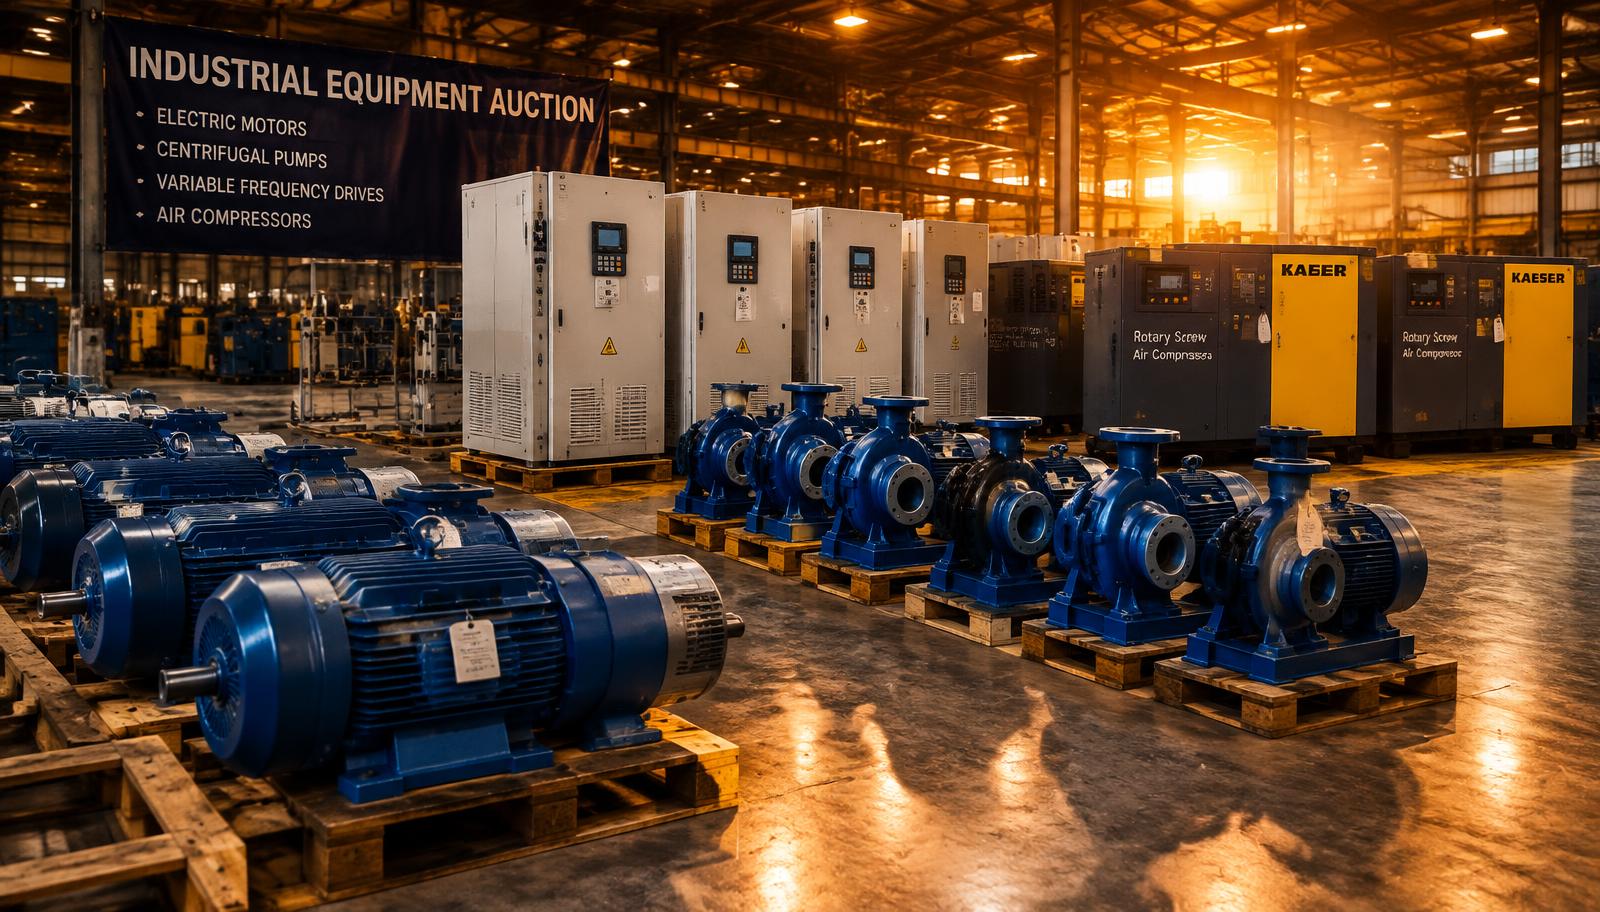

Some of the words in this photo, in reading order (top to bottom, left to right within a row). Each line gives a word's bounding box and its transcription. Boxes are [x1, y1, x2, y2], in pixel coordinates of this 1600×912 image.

[129, 46, 319, 97] INDUSTRIAL
[327, 68, 483, 113] EQUIPMENT
[489, 87, 595, 123] AUCTION
[157, 107, 236, 131] ELECTRIC
[241, 115, 307, 137] MOTORS
[157, 140, 270, 165] CENTRIFUGAL
[274, 149, 328, 169] PUMPS
[157, 173, 236, 195] VARIABLE
[240, 178, 330, 201] FREQUENCY
[334, 185, 385, 203] DRIVES
[157, 207, 185, 224] AIR
[191, 207, 312, 229] COMPRESSORS
[1511, 272, 1565, 284] KAESER
[1133, 330, 1171, 346] Rotary
[1133, 348, 1149, 361] Air
